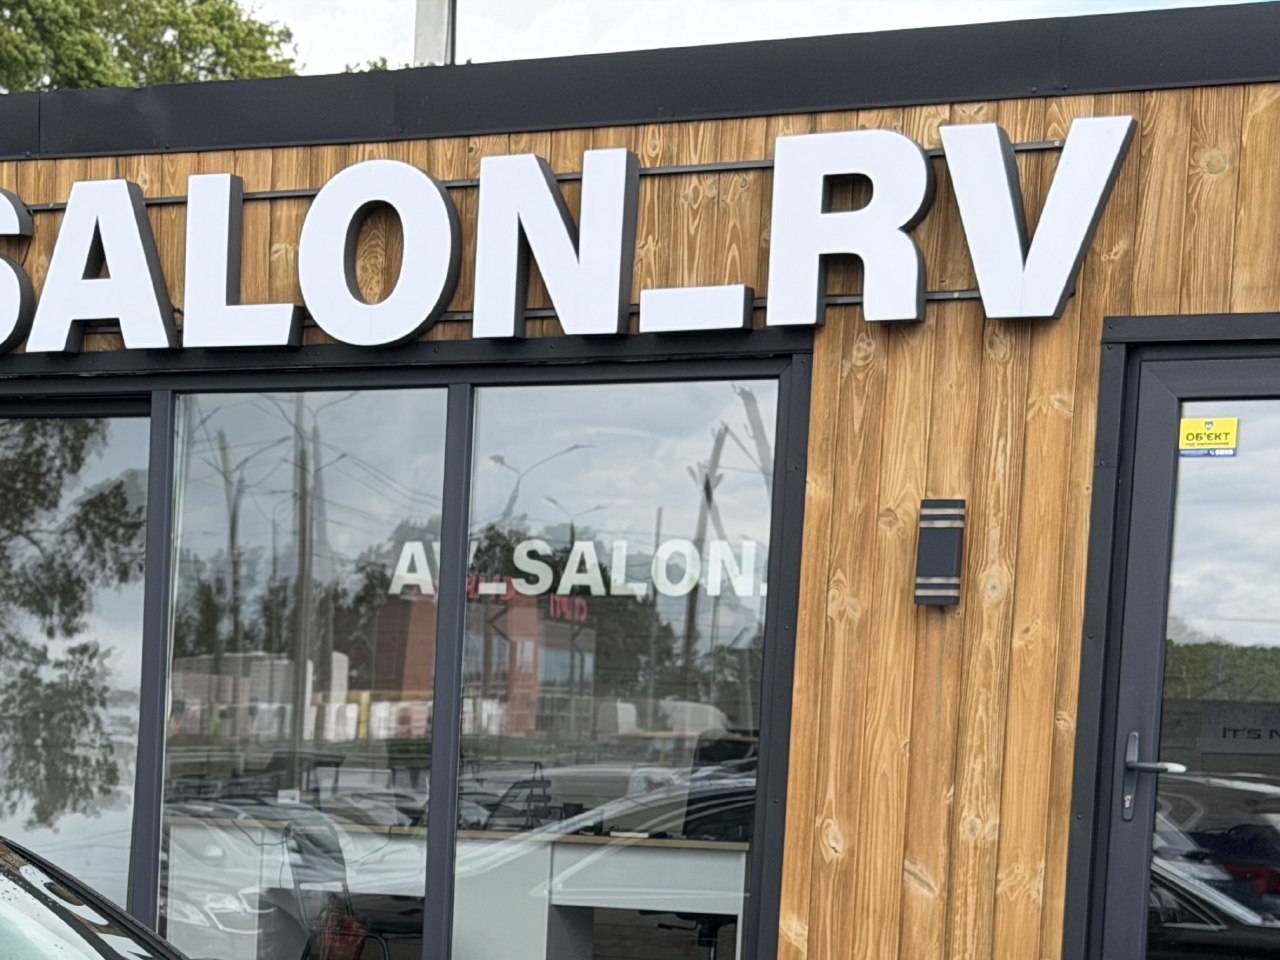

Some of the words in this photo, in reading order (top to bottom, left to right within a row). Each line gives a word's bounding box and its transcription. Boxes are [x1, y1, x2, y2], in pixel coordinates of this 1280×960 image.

[1186, 432, 1230, 441] ОБ'ЄКТ
[388, 539, 767, 597] A_SALON
[1222, 727, 1262, 740] IT'S
